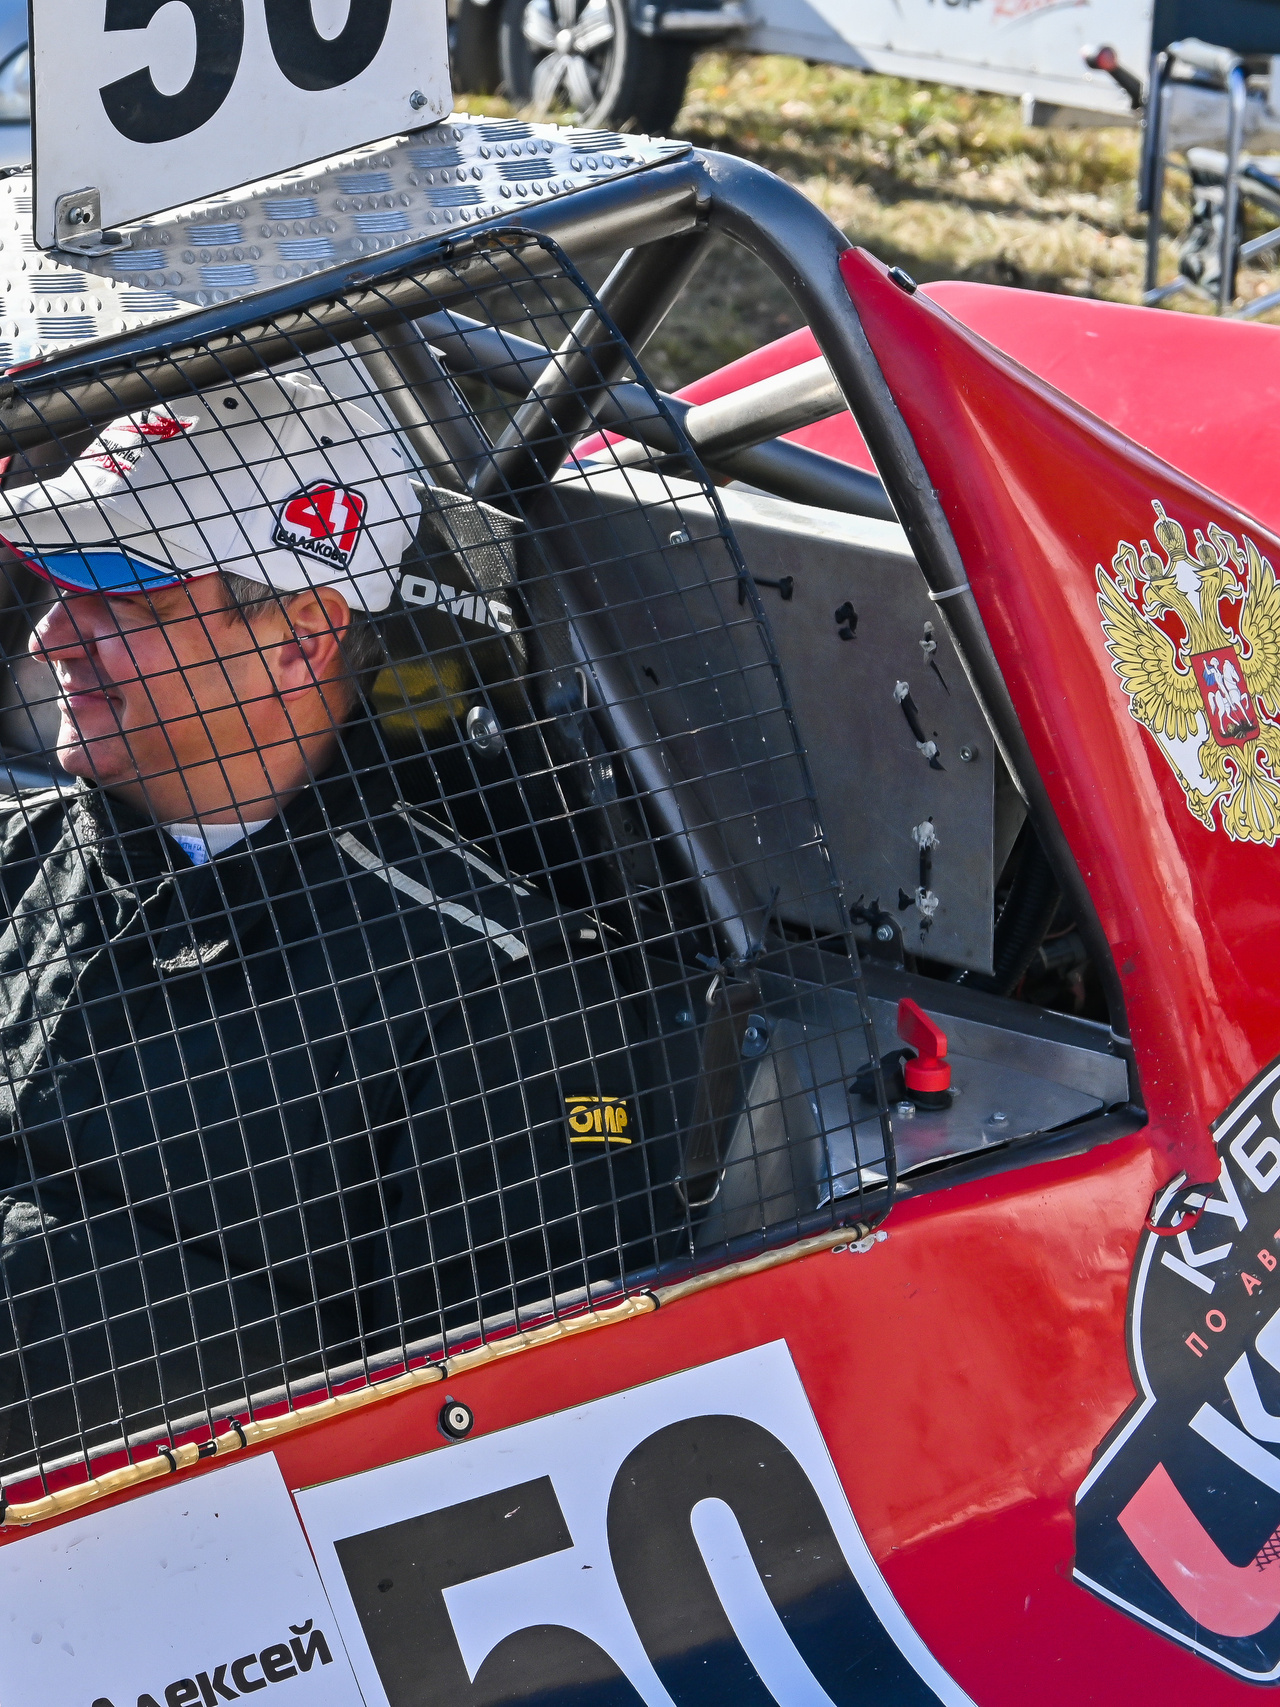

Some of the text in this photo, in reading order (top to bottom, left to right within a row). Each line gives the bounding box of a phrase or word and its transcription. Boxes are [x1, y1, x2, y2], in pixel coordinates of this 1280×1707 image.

[396, 571, 513, 633] OMIC
[568, 1104, 628, 1134] OMP
[1161, 1087, 1280, 1295] КУБ
[1185, 1229, 1280, 1358] ПО АВ
[91, 1618, 334, 1707] ексей
